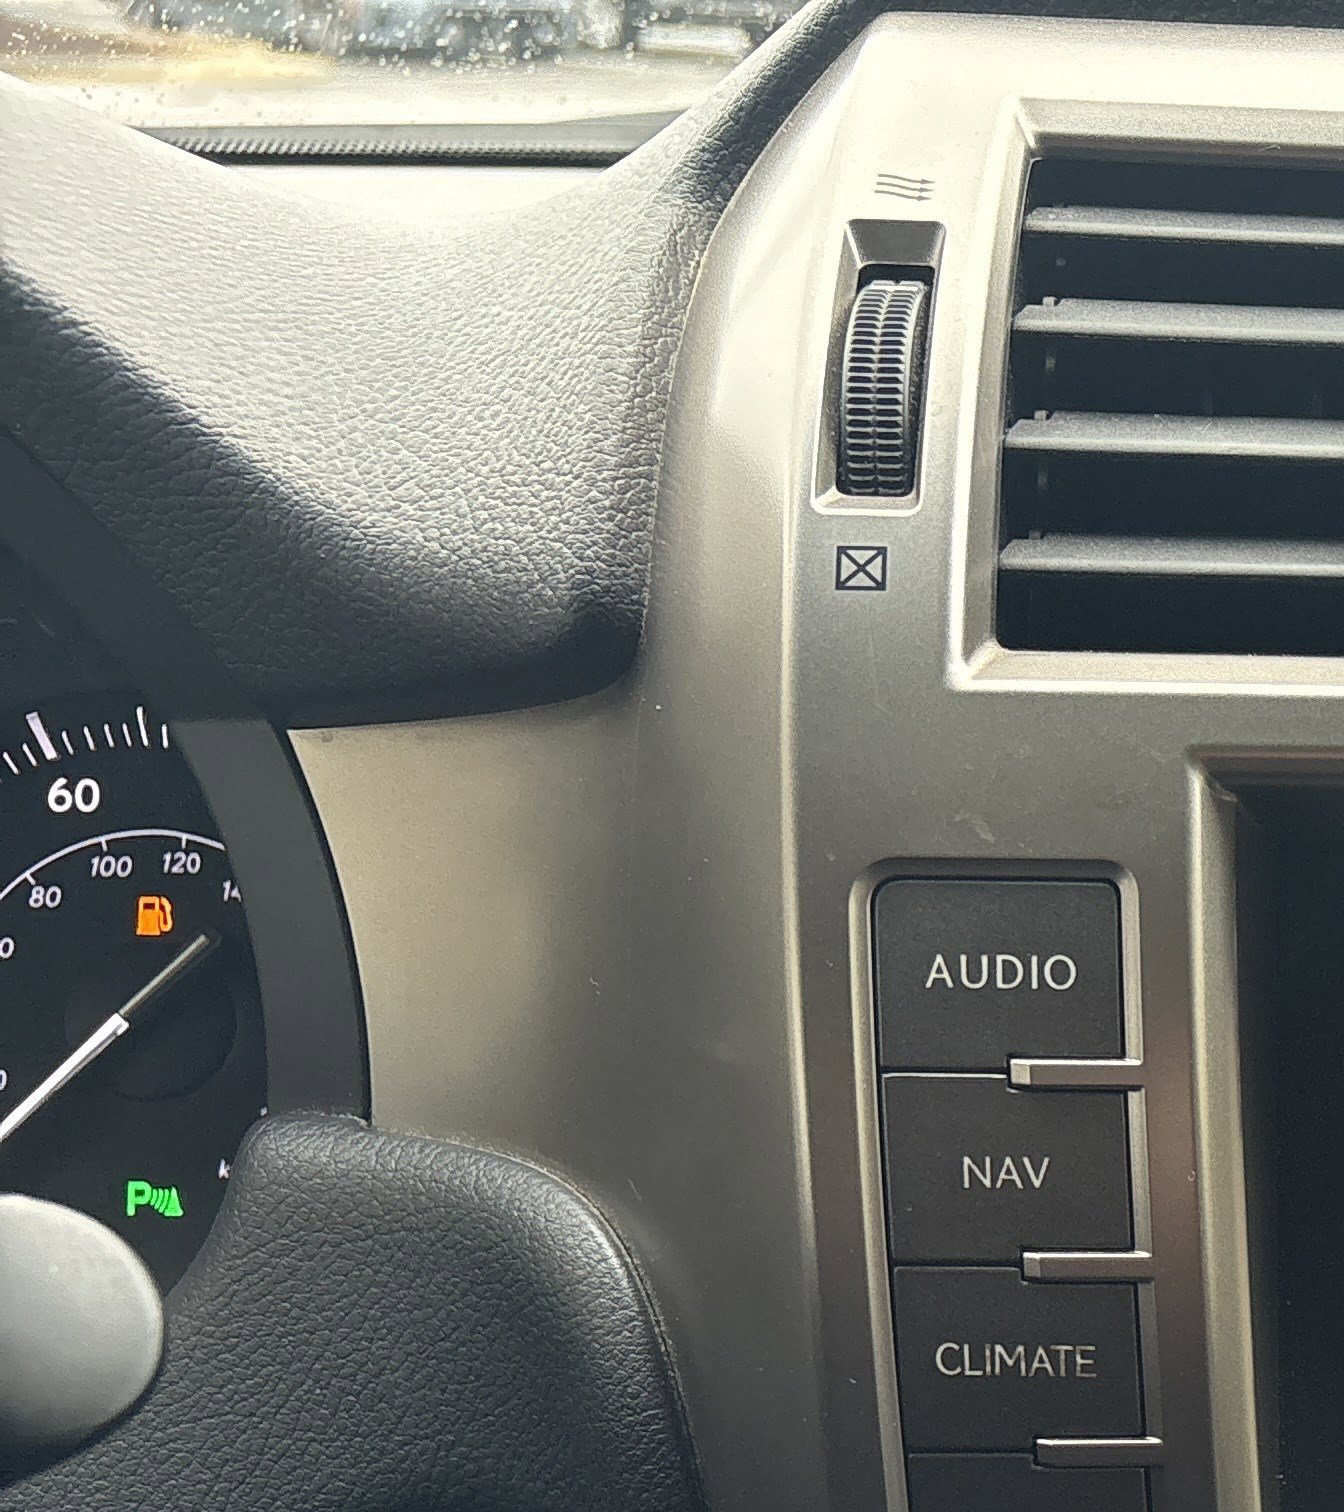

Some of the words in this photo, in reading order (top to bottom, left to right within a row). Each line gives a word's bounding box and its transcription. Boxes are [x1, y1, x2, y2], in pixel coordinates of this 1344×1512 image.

[48, 777, 101, 814] 60
[90, 855, 133, 879] 100
[162, 852, 201, 875] 120
[28, 884, 62, 909] 80
[925, 954, 1078, 990] AUDIO
[962, 1156, 1050, 1190] NAV
[935, 1342, 1098, 1379] CLIMATE
